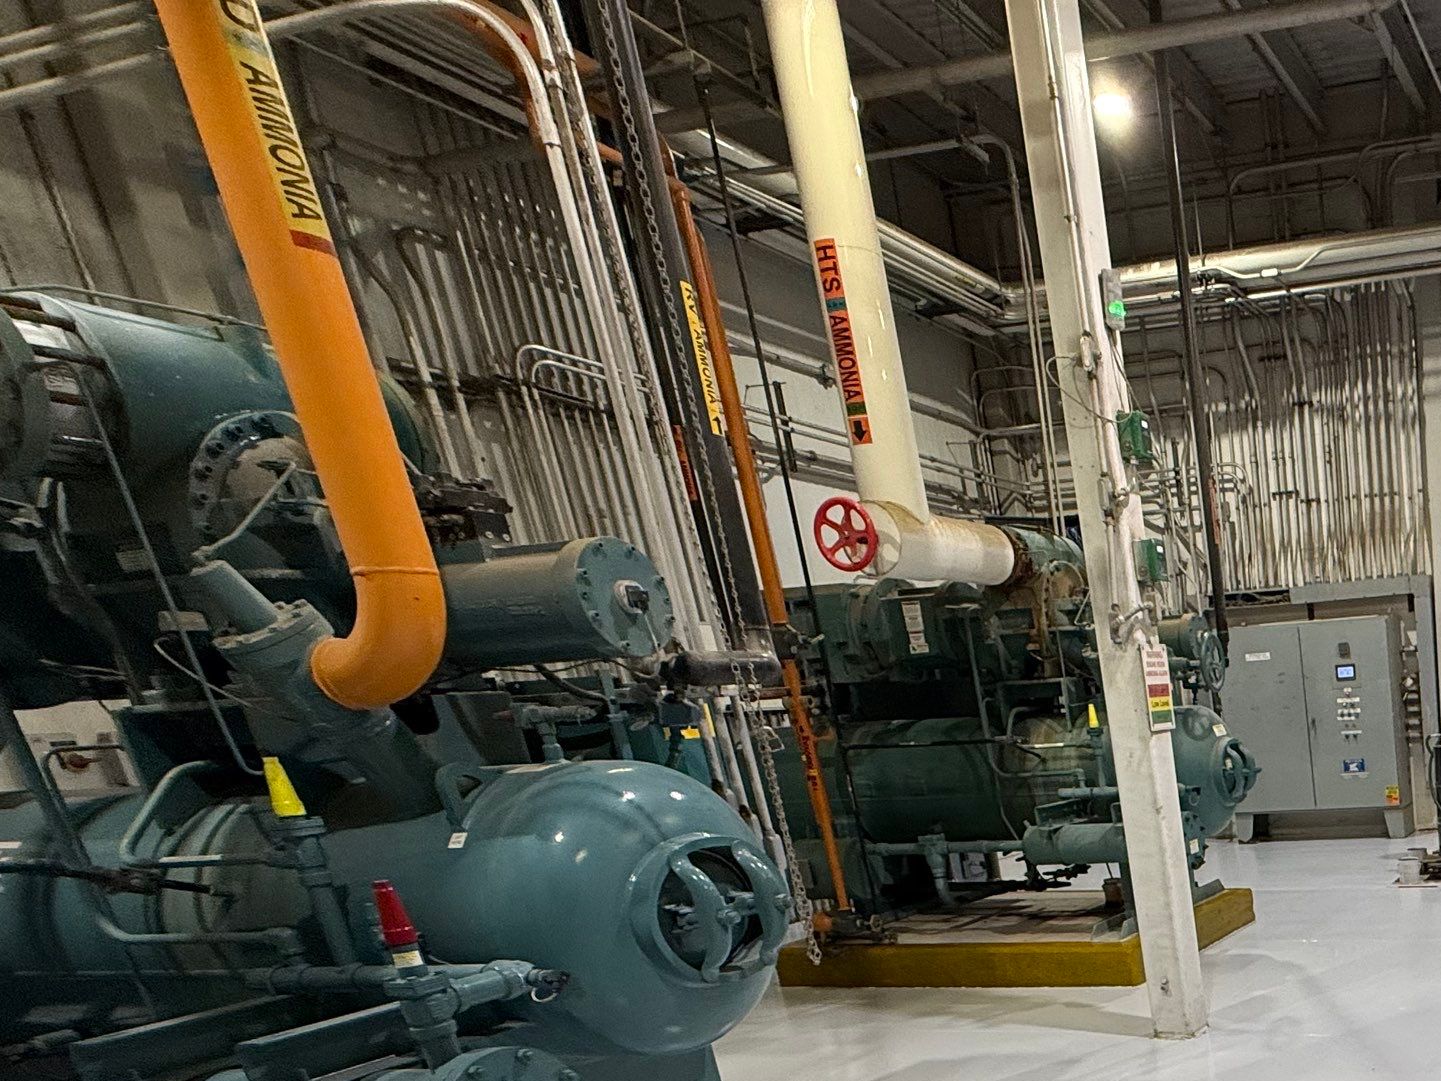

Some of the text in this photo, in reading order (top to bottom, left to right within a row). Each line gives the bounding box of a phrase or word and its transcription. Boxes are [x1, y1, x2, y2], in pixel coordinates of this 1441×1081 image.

[239, 60, 323, 221] AMMONIA
[692, 328, 723, 404] AMMONIA
[815, 243, 841, 293] HTS
[829, 314, 862, 401] AMMONIA
